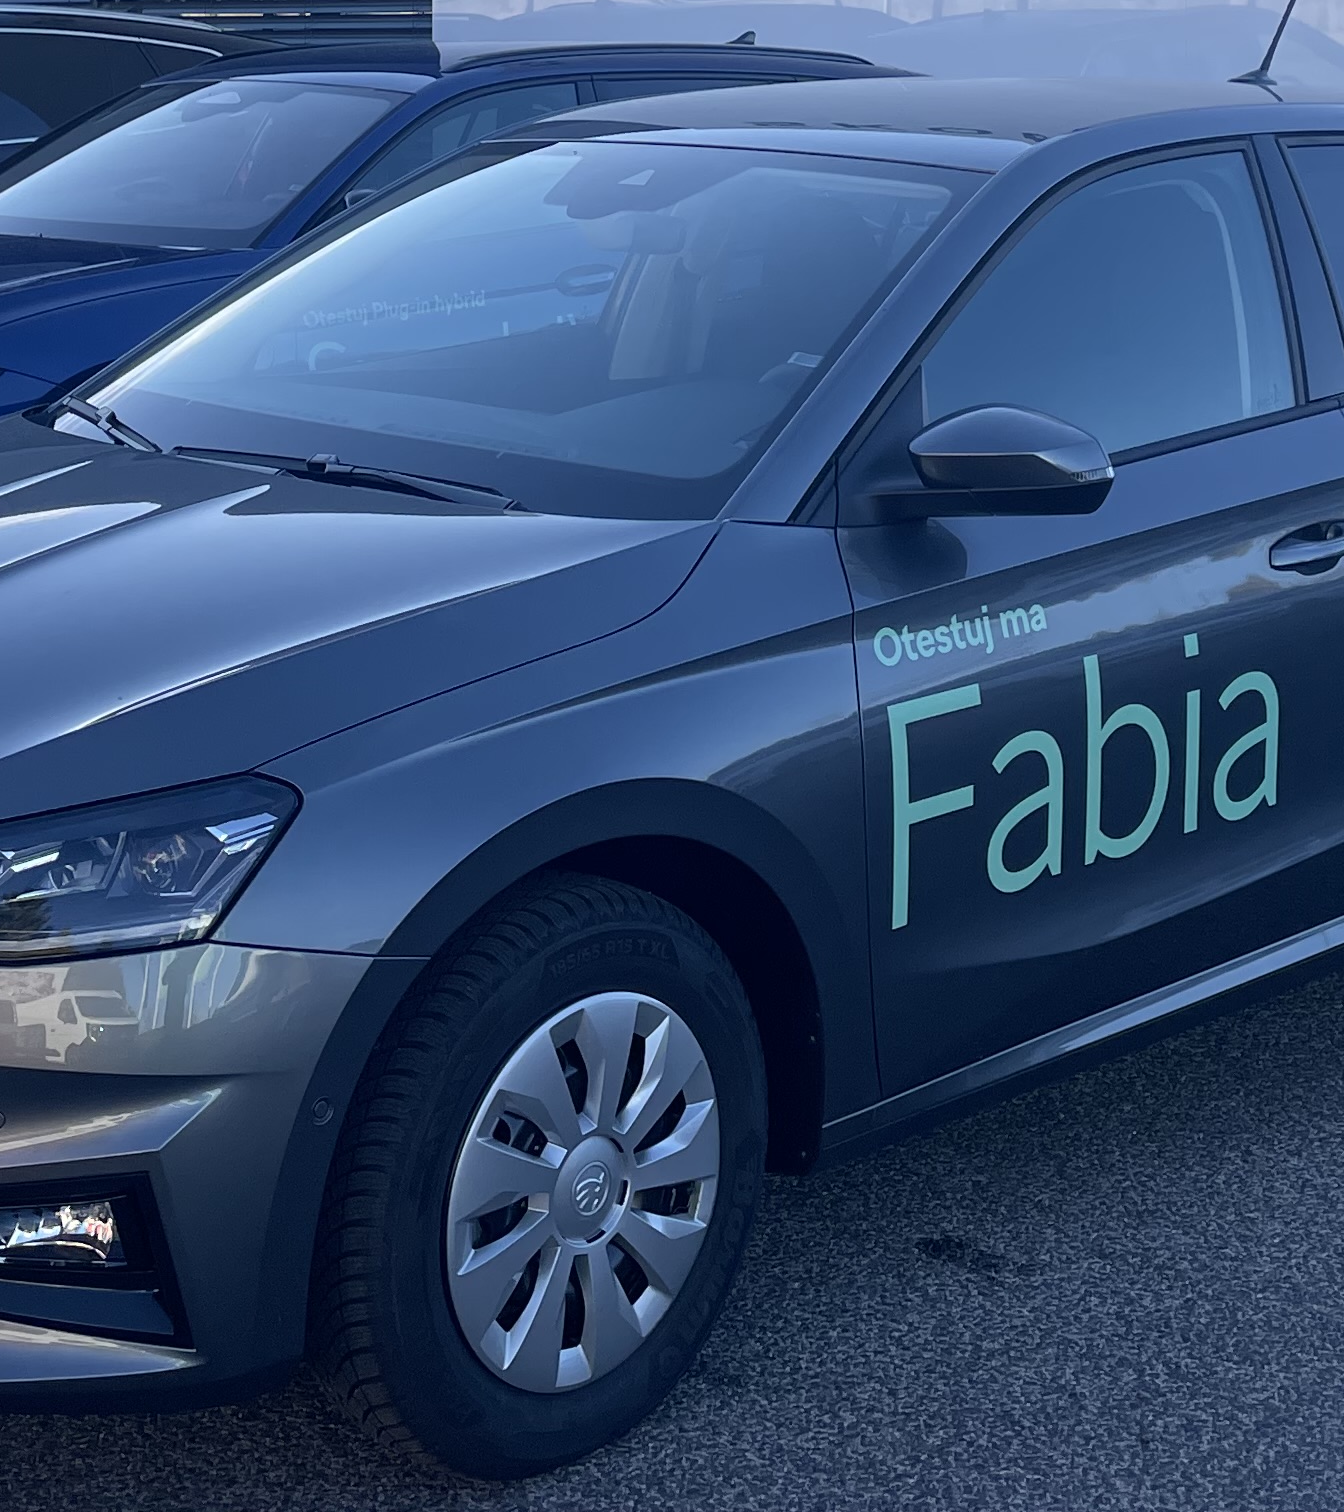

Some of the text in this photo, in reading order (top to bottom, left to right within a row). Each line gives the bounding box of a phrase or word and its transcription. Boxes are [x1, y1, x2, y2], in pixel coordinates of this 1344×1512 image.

[304, 290, 486, 328] Otestuj Plug-in hybrid
[873, 603, 1048, 667] Otestuj ma
[887, 632, 1280, 931] Fabia
